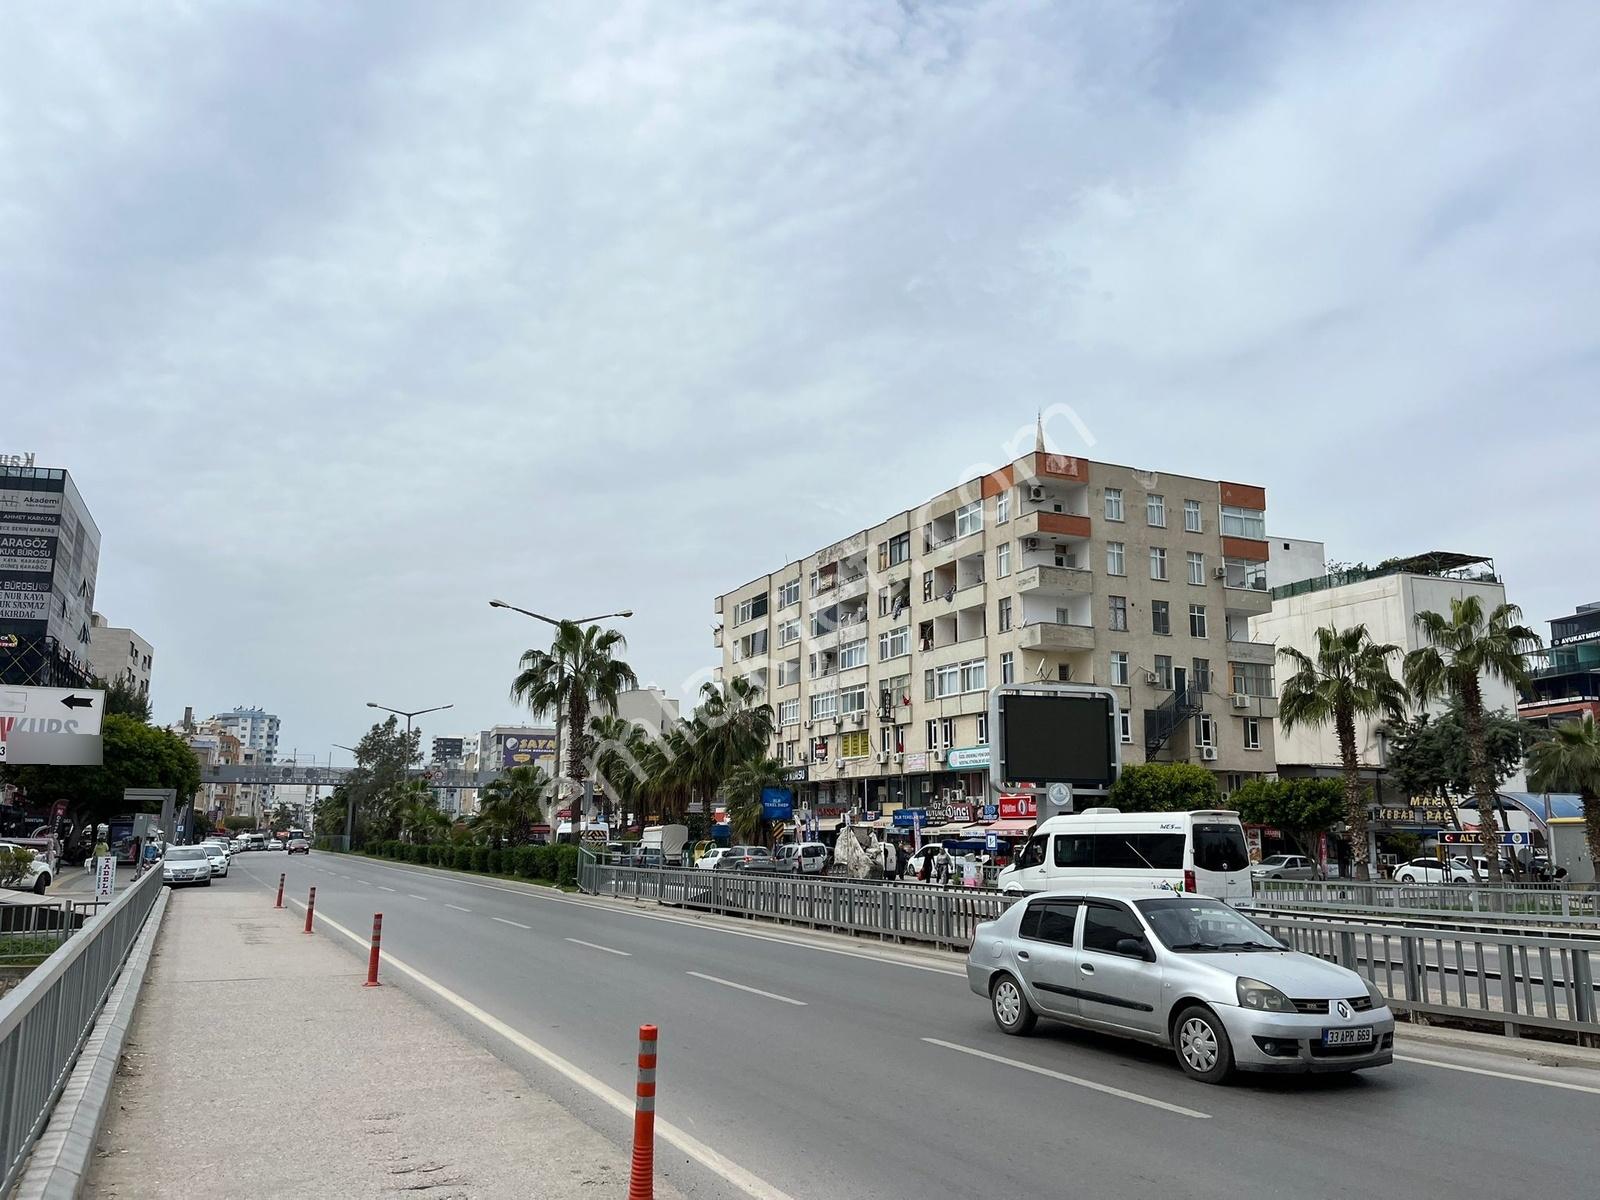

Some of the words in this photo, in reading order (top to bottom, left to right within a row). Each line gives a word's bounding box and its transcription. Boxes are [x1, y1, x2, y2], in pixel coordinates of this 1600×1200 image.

[0, 537, 48, 548] ARAGÖZ
[17, 548, 51, 557] BÜROSU
[5, 592, 21, 600] NUR
[24, 593, 44, 601] KAYA
[1561, 633, 1586, 644] AVUKAT
[1460, 834, 1476, 842] ALT
[1329, 1031, 1340, 1043] 33
[1341, 1030, 1355, 1042] APR
[1358, 1029, 1370, 1041] 669
